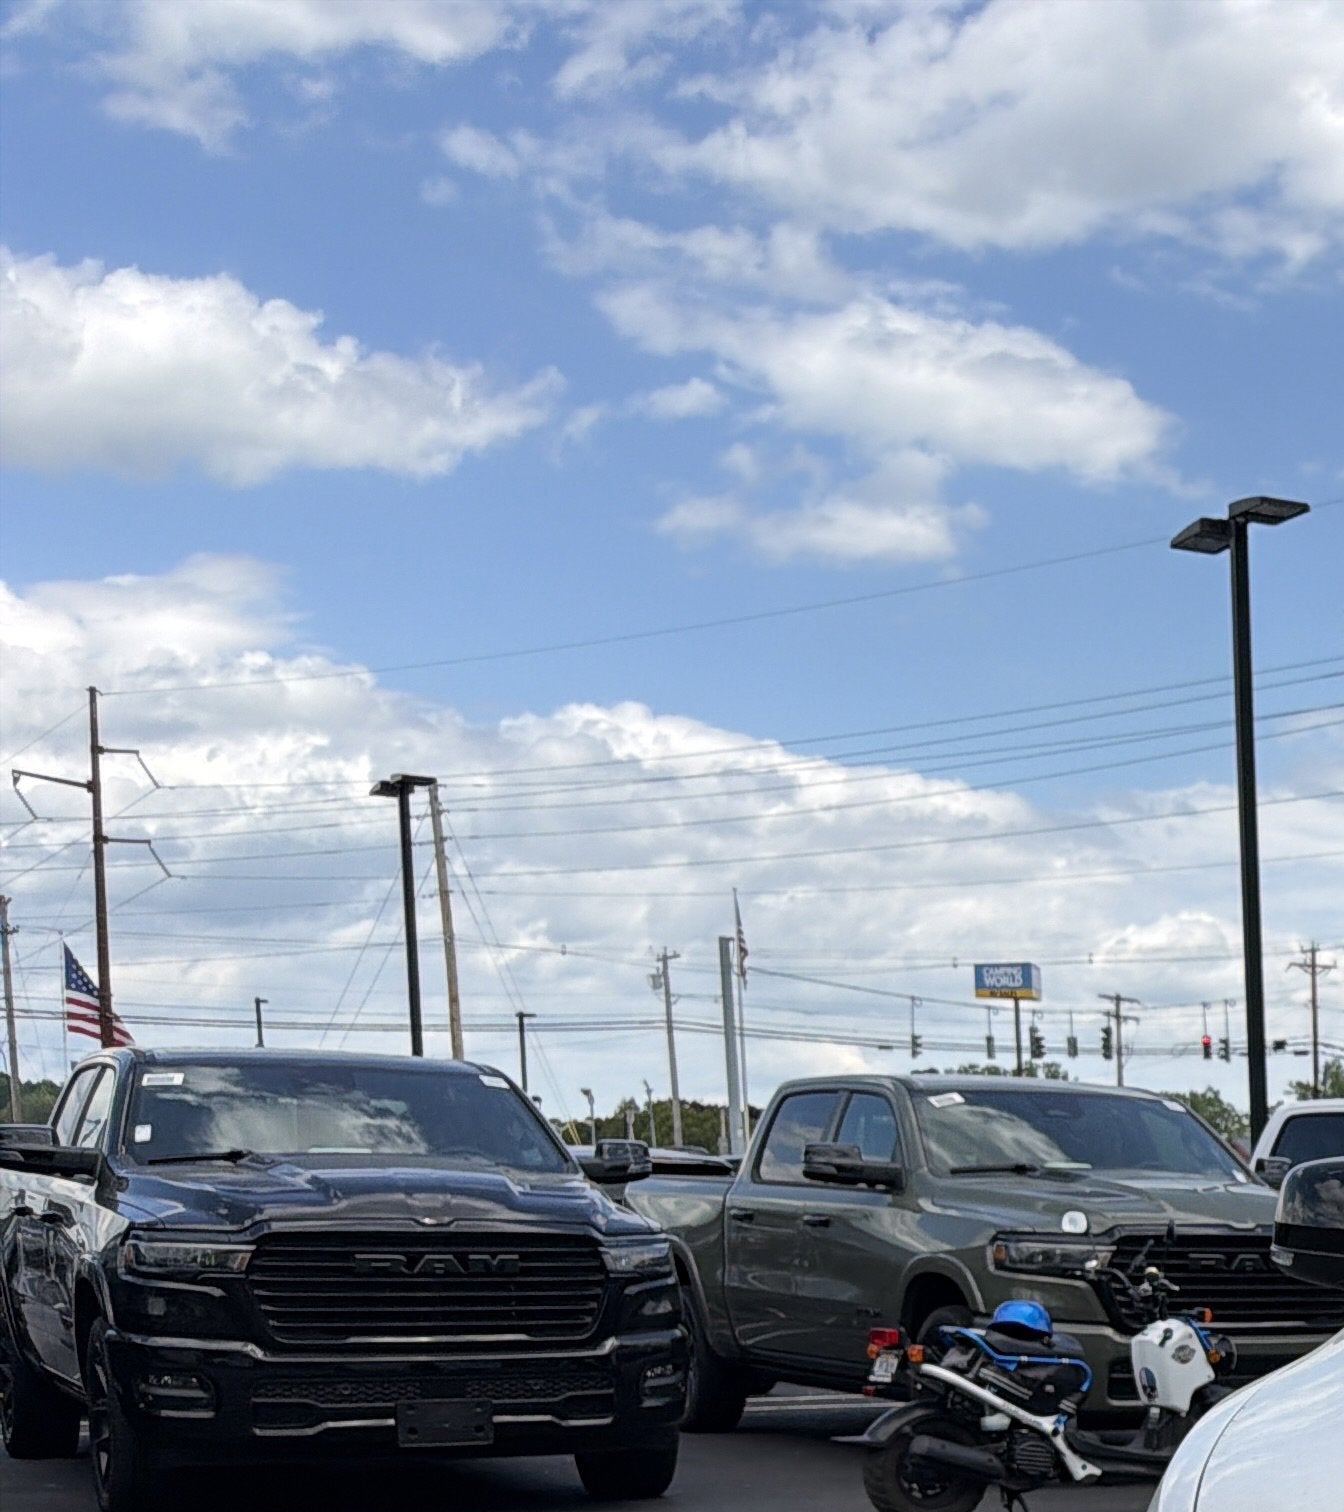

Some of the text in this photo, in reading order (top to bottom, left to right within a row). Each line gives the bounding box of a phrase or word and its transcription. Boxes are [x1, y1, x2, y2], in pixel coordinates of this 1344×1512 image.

[984, 974, 1023, 988] WORLD
[355, 1254, 520, 1273] RAM
[1188, 1253, 1270, 1271] RA
